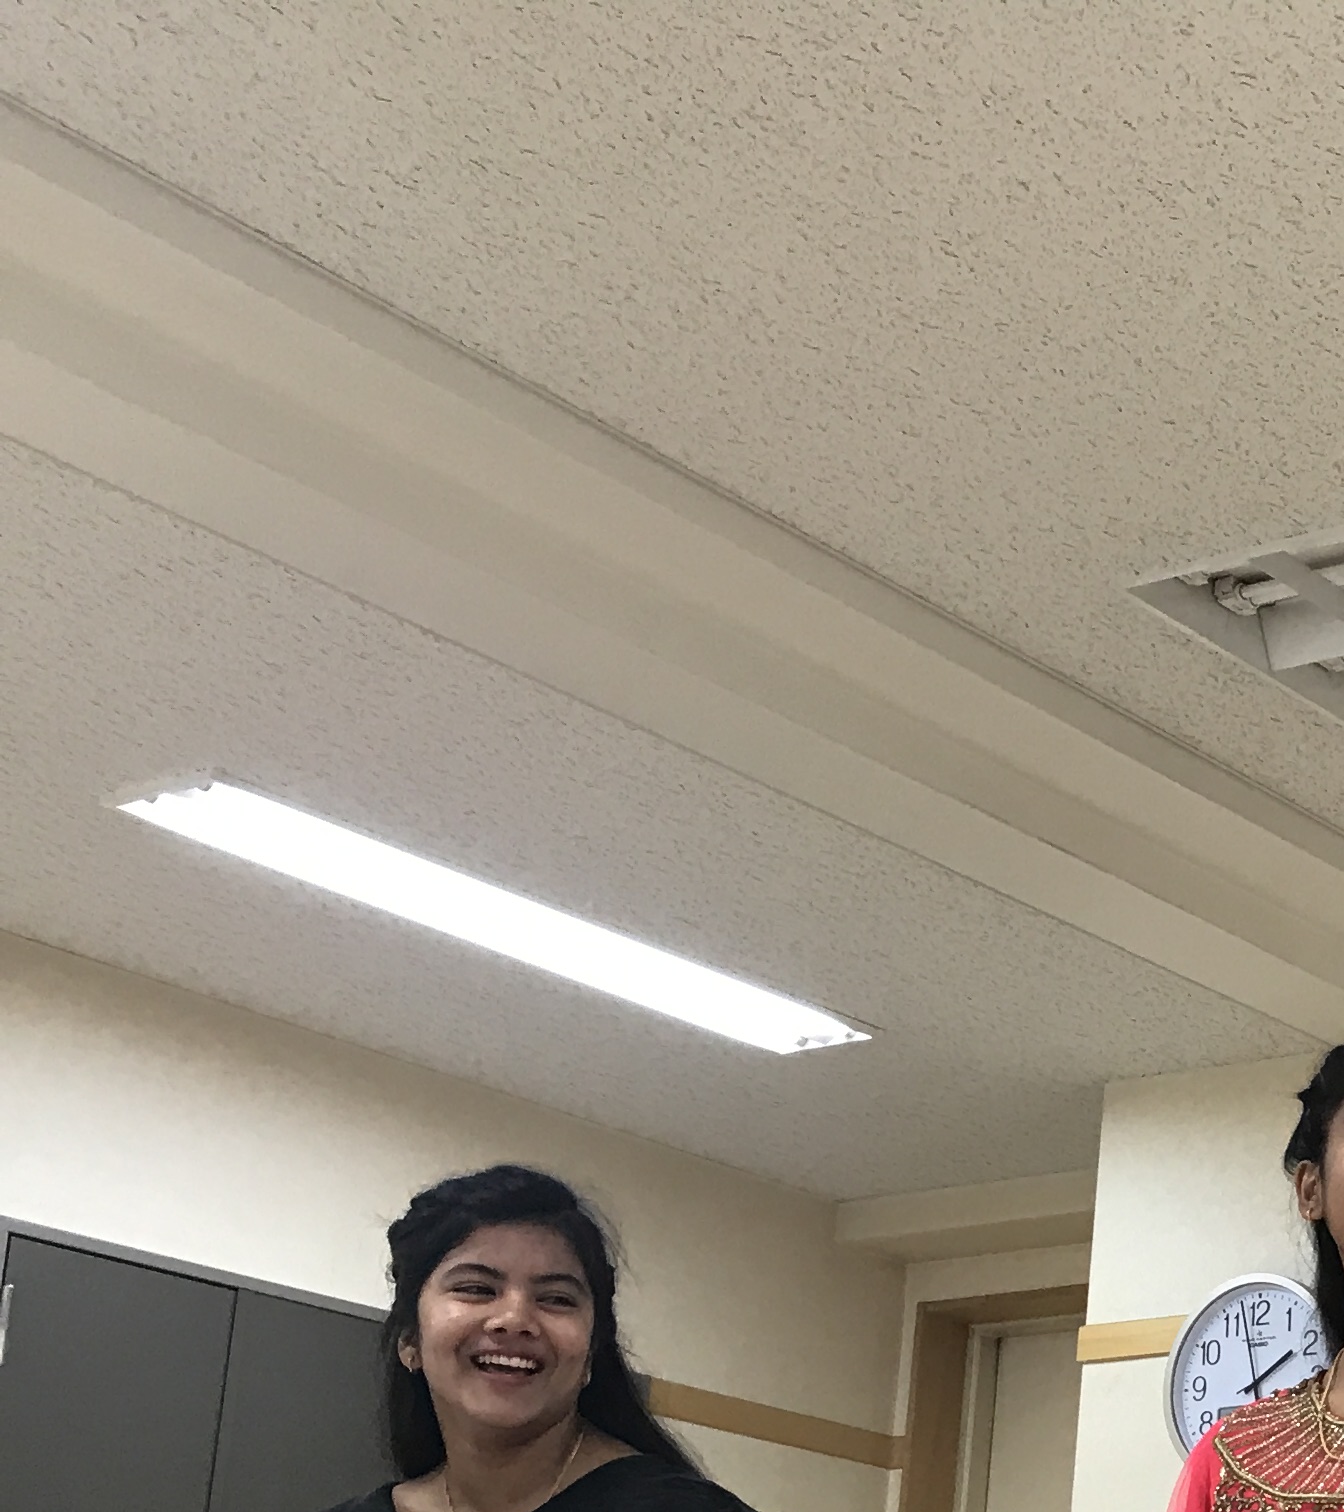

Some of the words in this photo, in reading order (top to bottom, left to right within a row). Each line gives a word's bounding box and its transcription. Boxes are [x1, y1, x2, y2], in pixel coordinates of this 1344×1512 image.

[1224, 1313, 1240, 1338] 11
[1250, 1300, 1271, 1326] 12
[1286, 1307, 1292, 1332] 1
[1201, 1340, 1221, 1366] 10
[1302, 1330, 1318, 1356] 2
[1192, 1376, 1207, 1401] 9
[1199, 1411, 1213, 1435] 8
